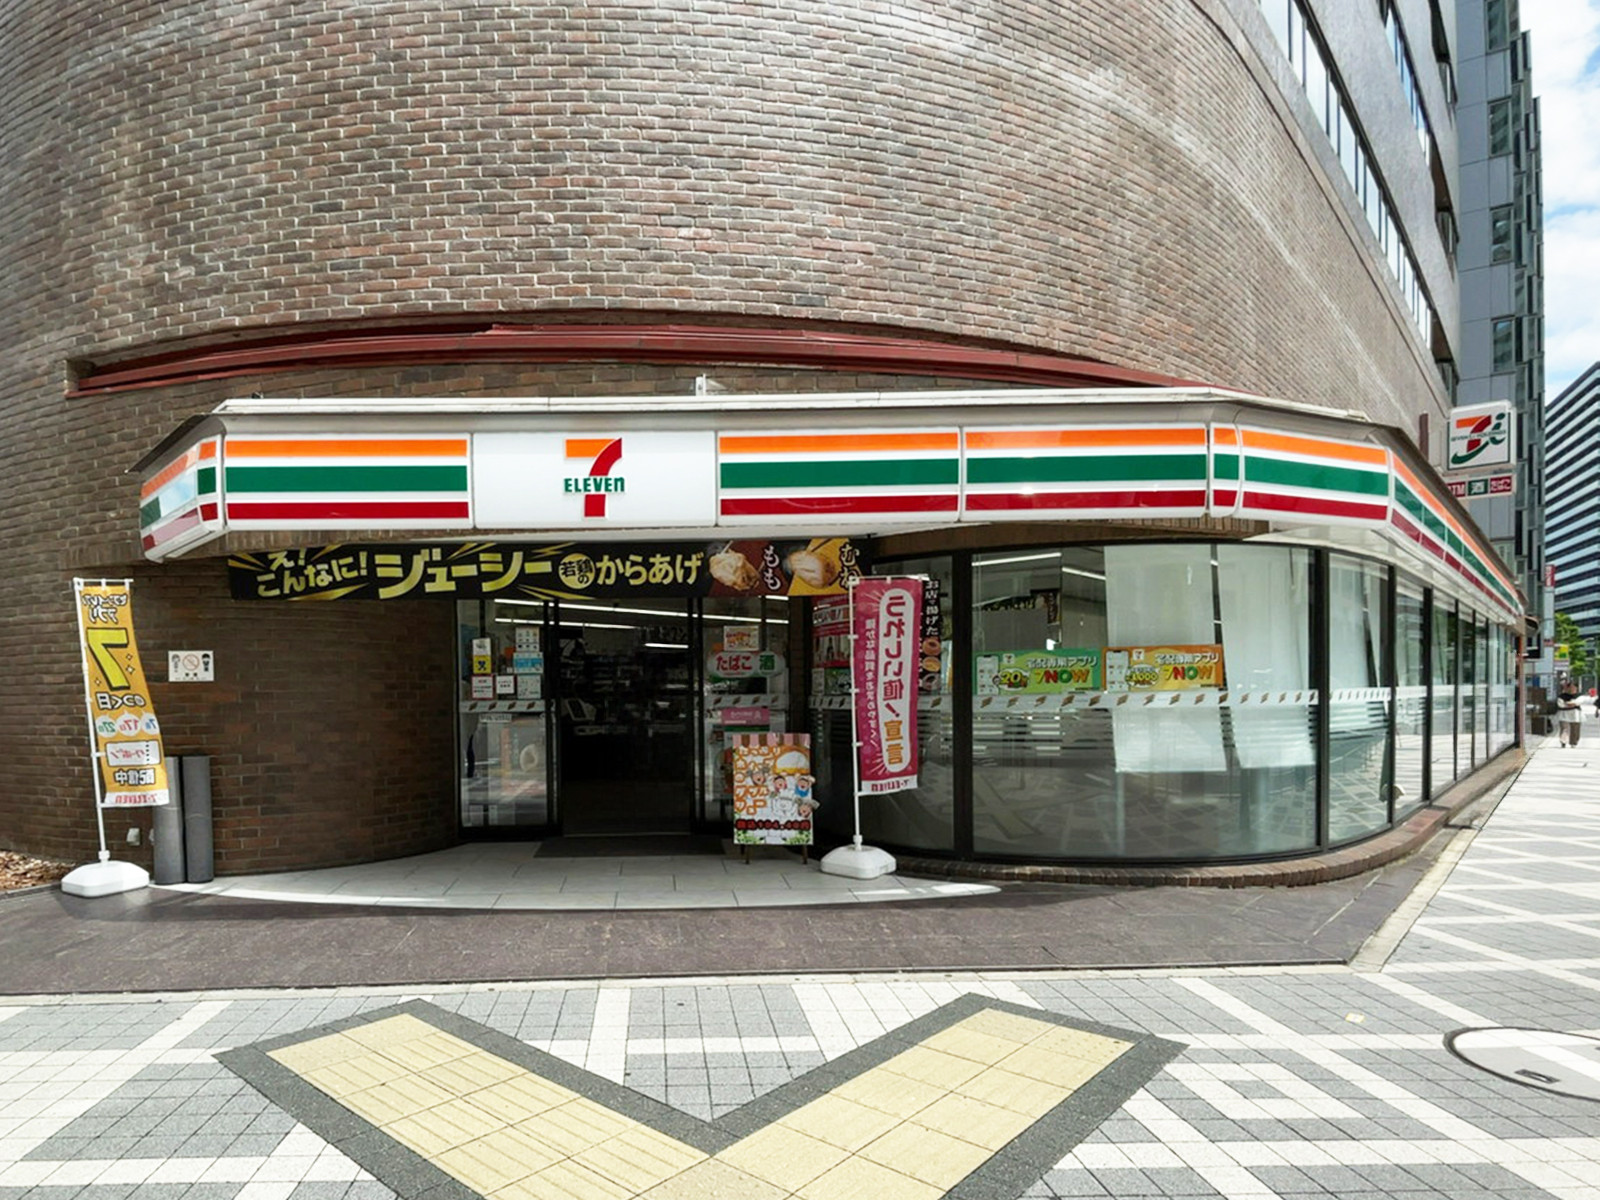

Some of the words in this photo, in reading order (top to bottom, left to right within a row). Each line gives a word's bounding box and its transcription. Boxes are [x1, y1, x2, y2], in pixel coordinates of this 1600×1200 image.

[374, 548, 552, 599] ジューシー
[597, 551, 704, 585] からあげ
[715, 655, 753, 672] たばこ
[759, 655, 775, 671] 酒
